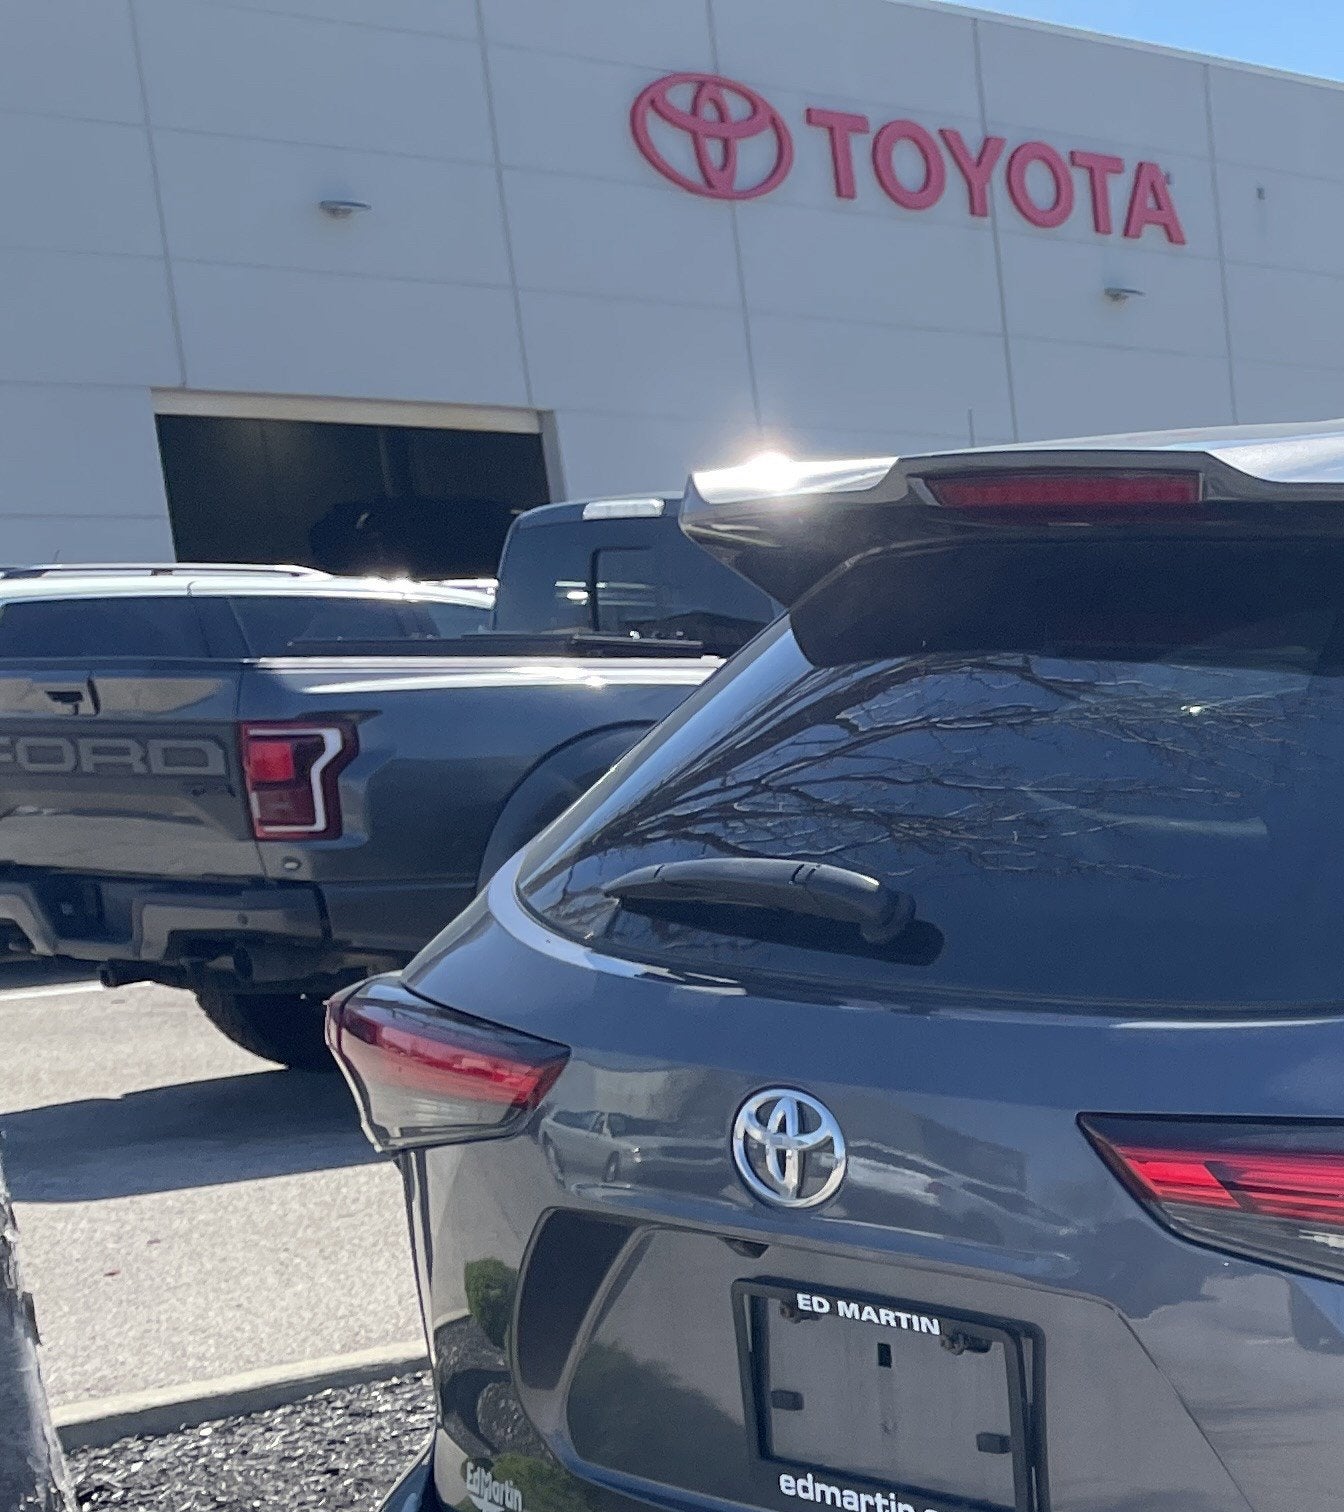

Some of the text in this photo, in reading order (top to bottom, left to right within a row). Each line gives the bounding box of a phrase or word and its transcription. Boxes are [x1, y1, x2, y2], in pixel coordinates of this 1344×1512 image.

[806, 107, 1186, 245] TOYOTA
[0, 736, 226, 776] ORD
[796, 1293, 941, 1336] ED MARTIN
